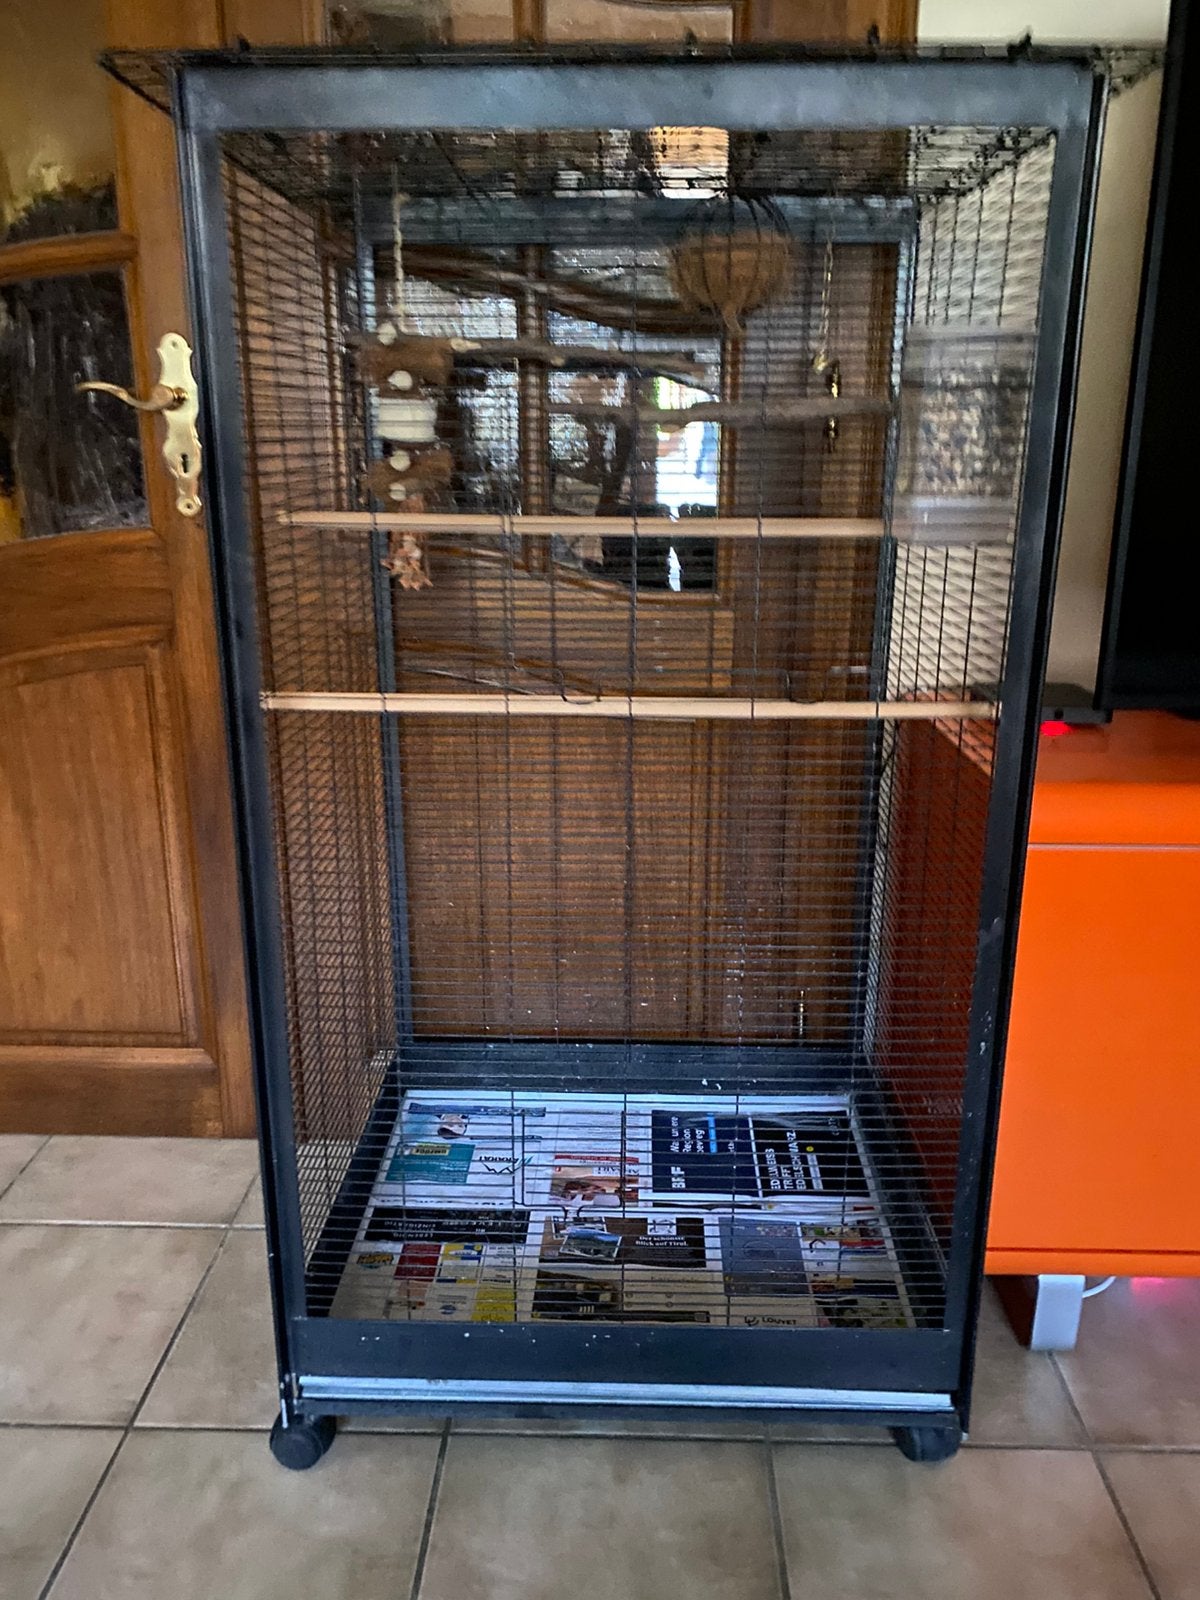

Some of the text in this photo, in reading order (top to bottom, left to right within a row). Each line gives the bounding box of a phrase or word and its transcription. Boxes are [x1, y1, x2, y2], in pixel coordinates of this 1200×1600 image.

[670, 1116, 679, 1137] unere
[694, 1128, 706, 1153] eweg
[765, 1148, 781, 1190] EDLWEISS
[780, 1166, 794, 1190] TRFF
